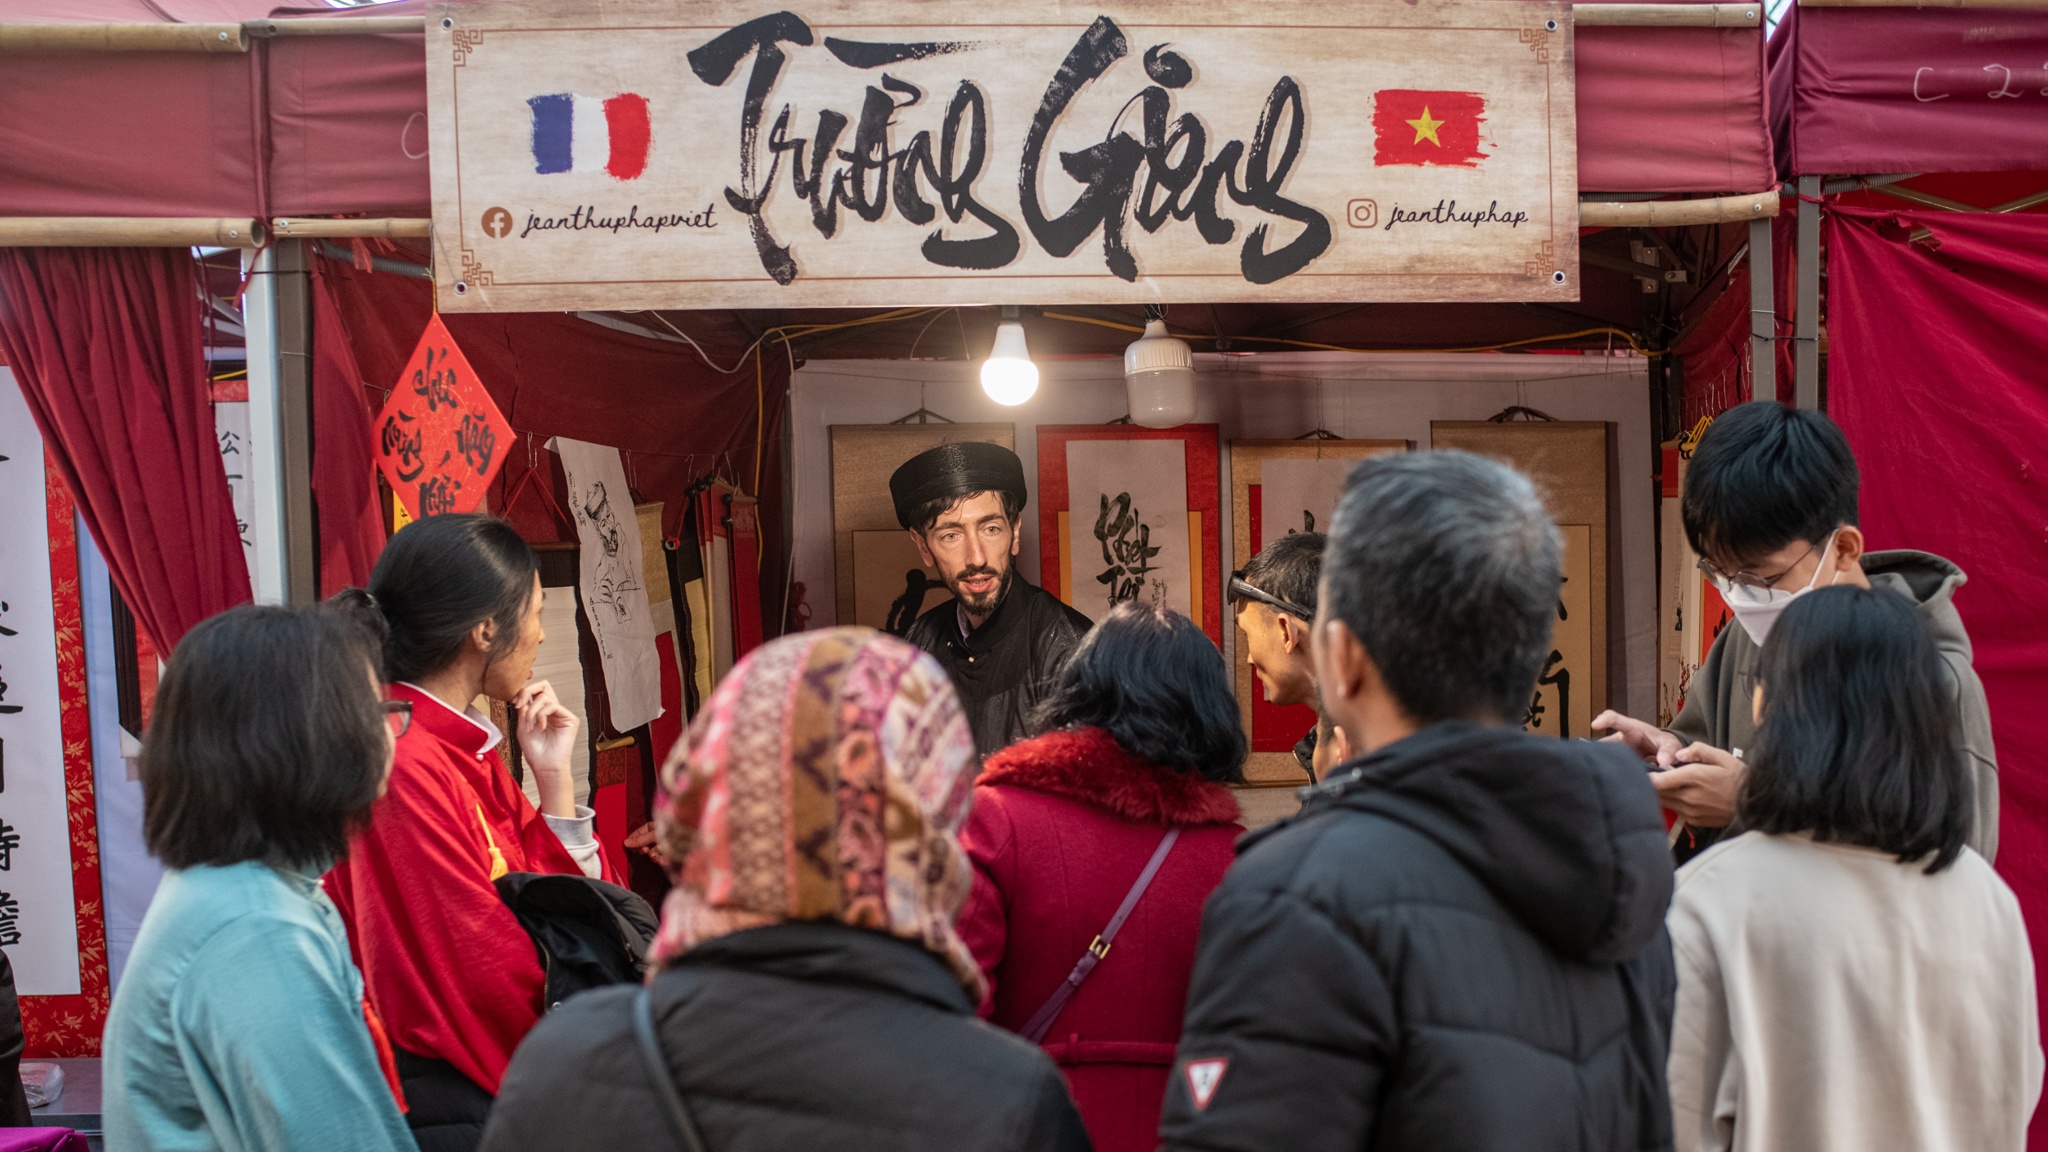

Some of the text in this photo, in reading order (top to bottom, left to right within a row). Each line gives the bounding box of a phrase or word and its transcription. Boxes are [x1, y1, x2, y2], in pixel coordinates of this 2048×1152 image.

[1018, 14, 1332, 286] Giang
[520, 202, 719, 239] jeanthuphapviet
[1384, 199, 1529, 231] jeanthuphap
